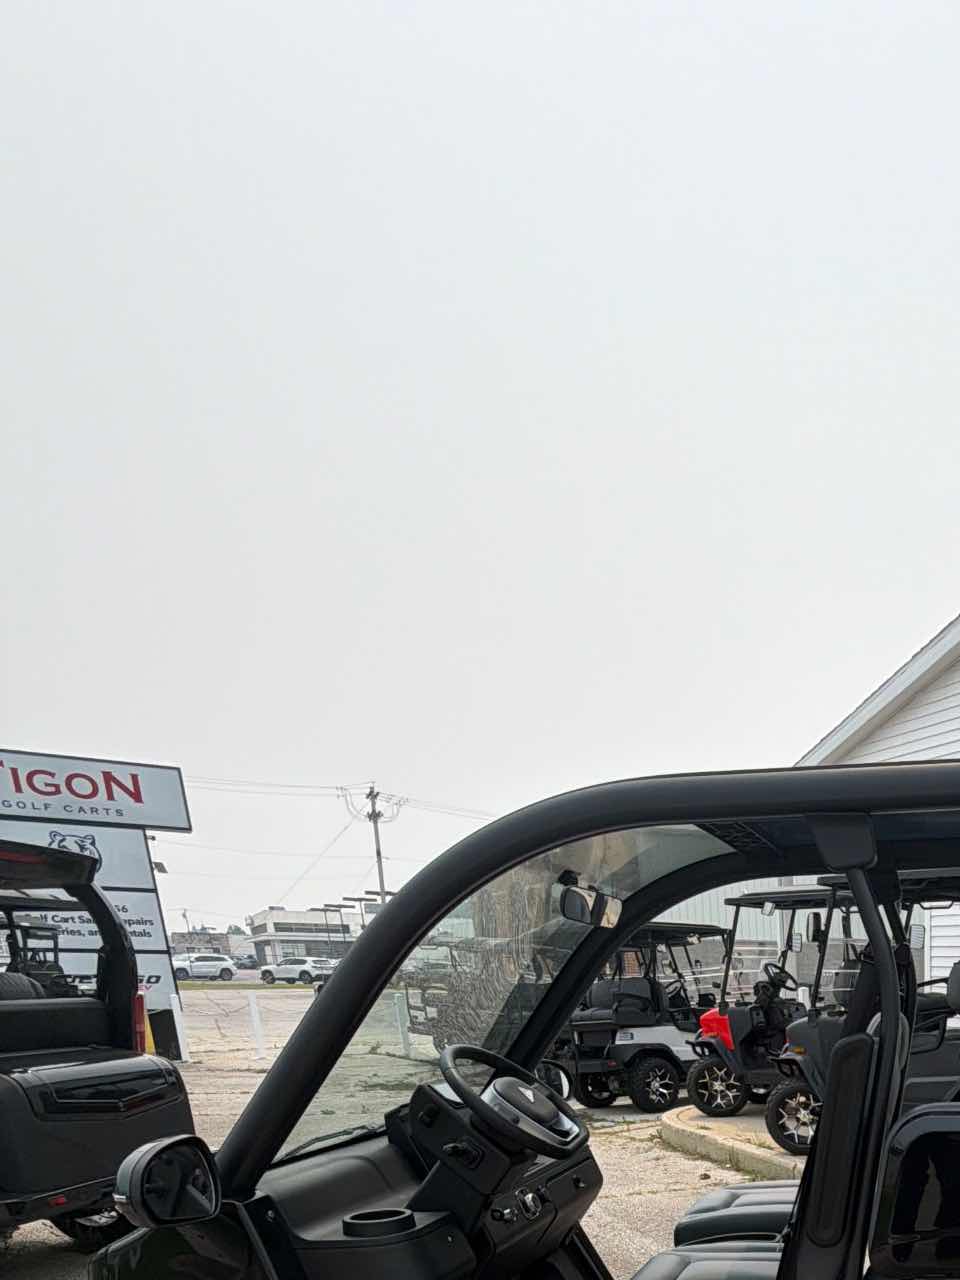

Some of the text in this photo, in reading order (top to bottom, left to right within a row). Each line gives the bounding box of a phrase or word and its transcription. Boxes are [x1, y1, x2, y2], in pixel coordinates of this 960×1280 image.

[0, 760, 144, 804] IGON
[1, 800, 124, 817] GOLF CARTS
[51, 914, 77, 924] Cart
[124, 917, 154, 928] pairs
